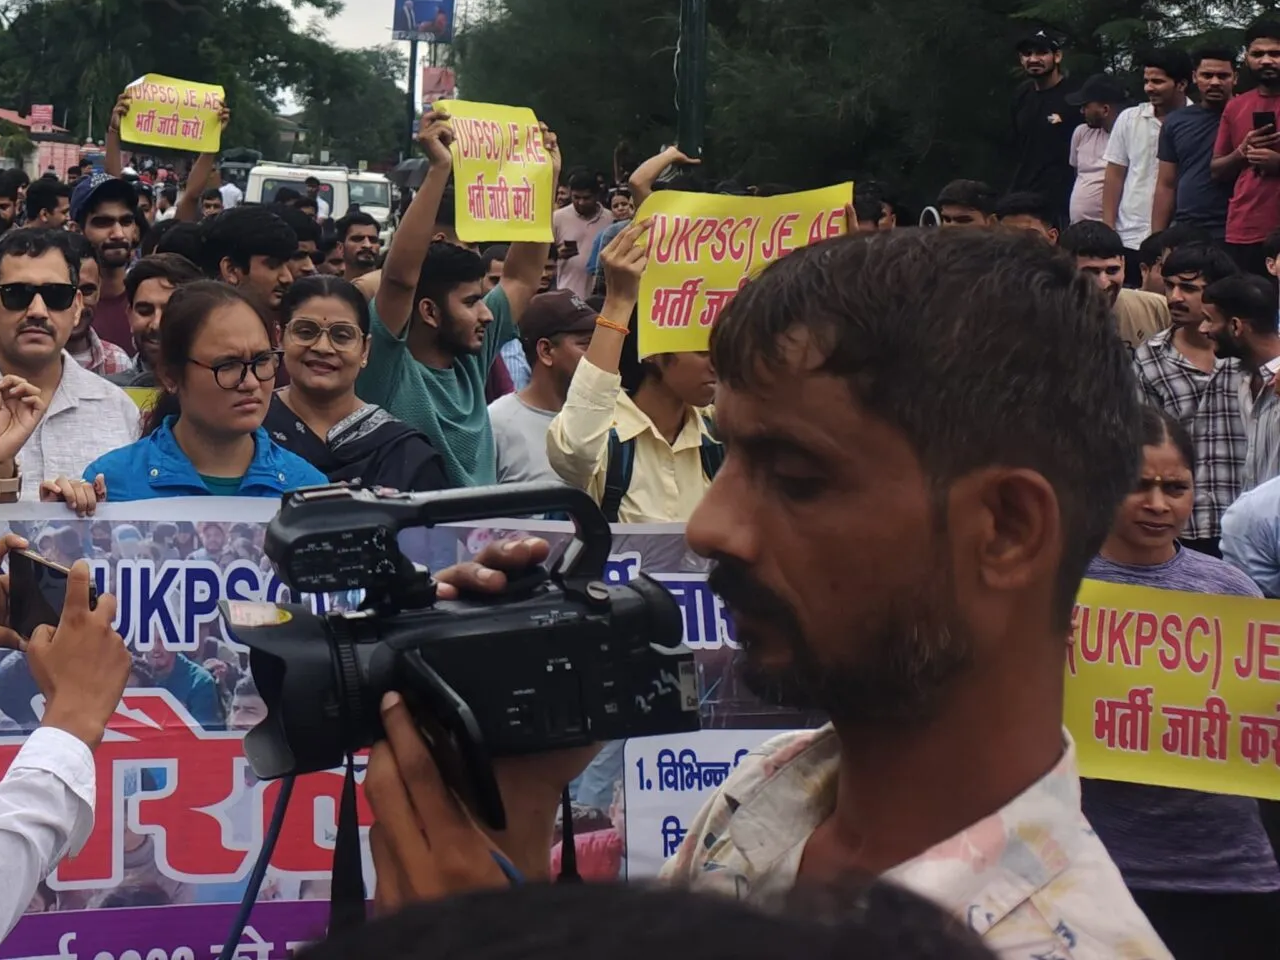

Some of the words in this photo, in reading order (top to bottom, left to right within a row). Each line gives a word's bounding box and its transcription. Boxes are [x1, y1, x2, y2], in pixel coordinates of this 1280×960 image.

[136, 110, 156, 132] भर्ती
[158, 114, 178, 136] जारी
[203, 93, 219, 110] AE
[452, 117, 504, 171] (UKPSC)
[526, 125, 545, 163] AE
[468, 174, 486, 219] भर्ती
[487, 176, 510, 220] जारी
[762, 214, 801, 259] JE
[651, 278, 704, 327] भर्ती
[1068, 605, 1223, 690] (UKPSC)
[1095, 687, 1153, 752] भर्ती
[1161, 697, 1231, 761] जारी
[636, 757, 652, 790] 1.
[657, 749, 730, 791] विभिन्न
